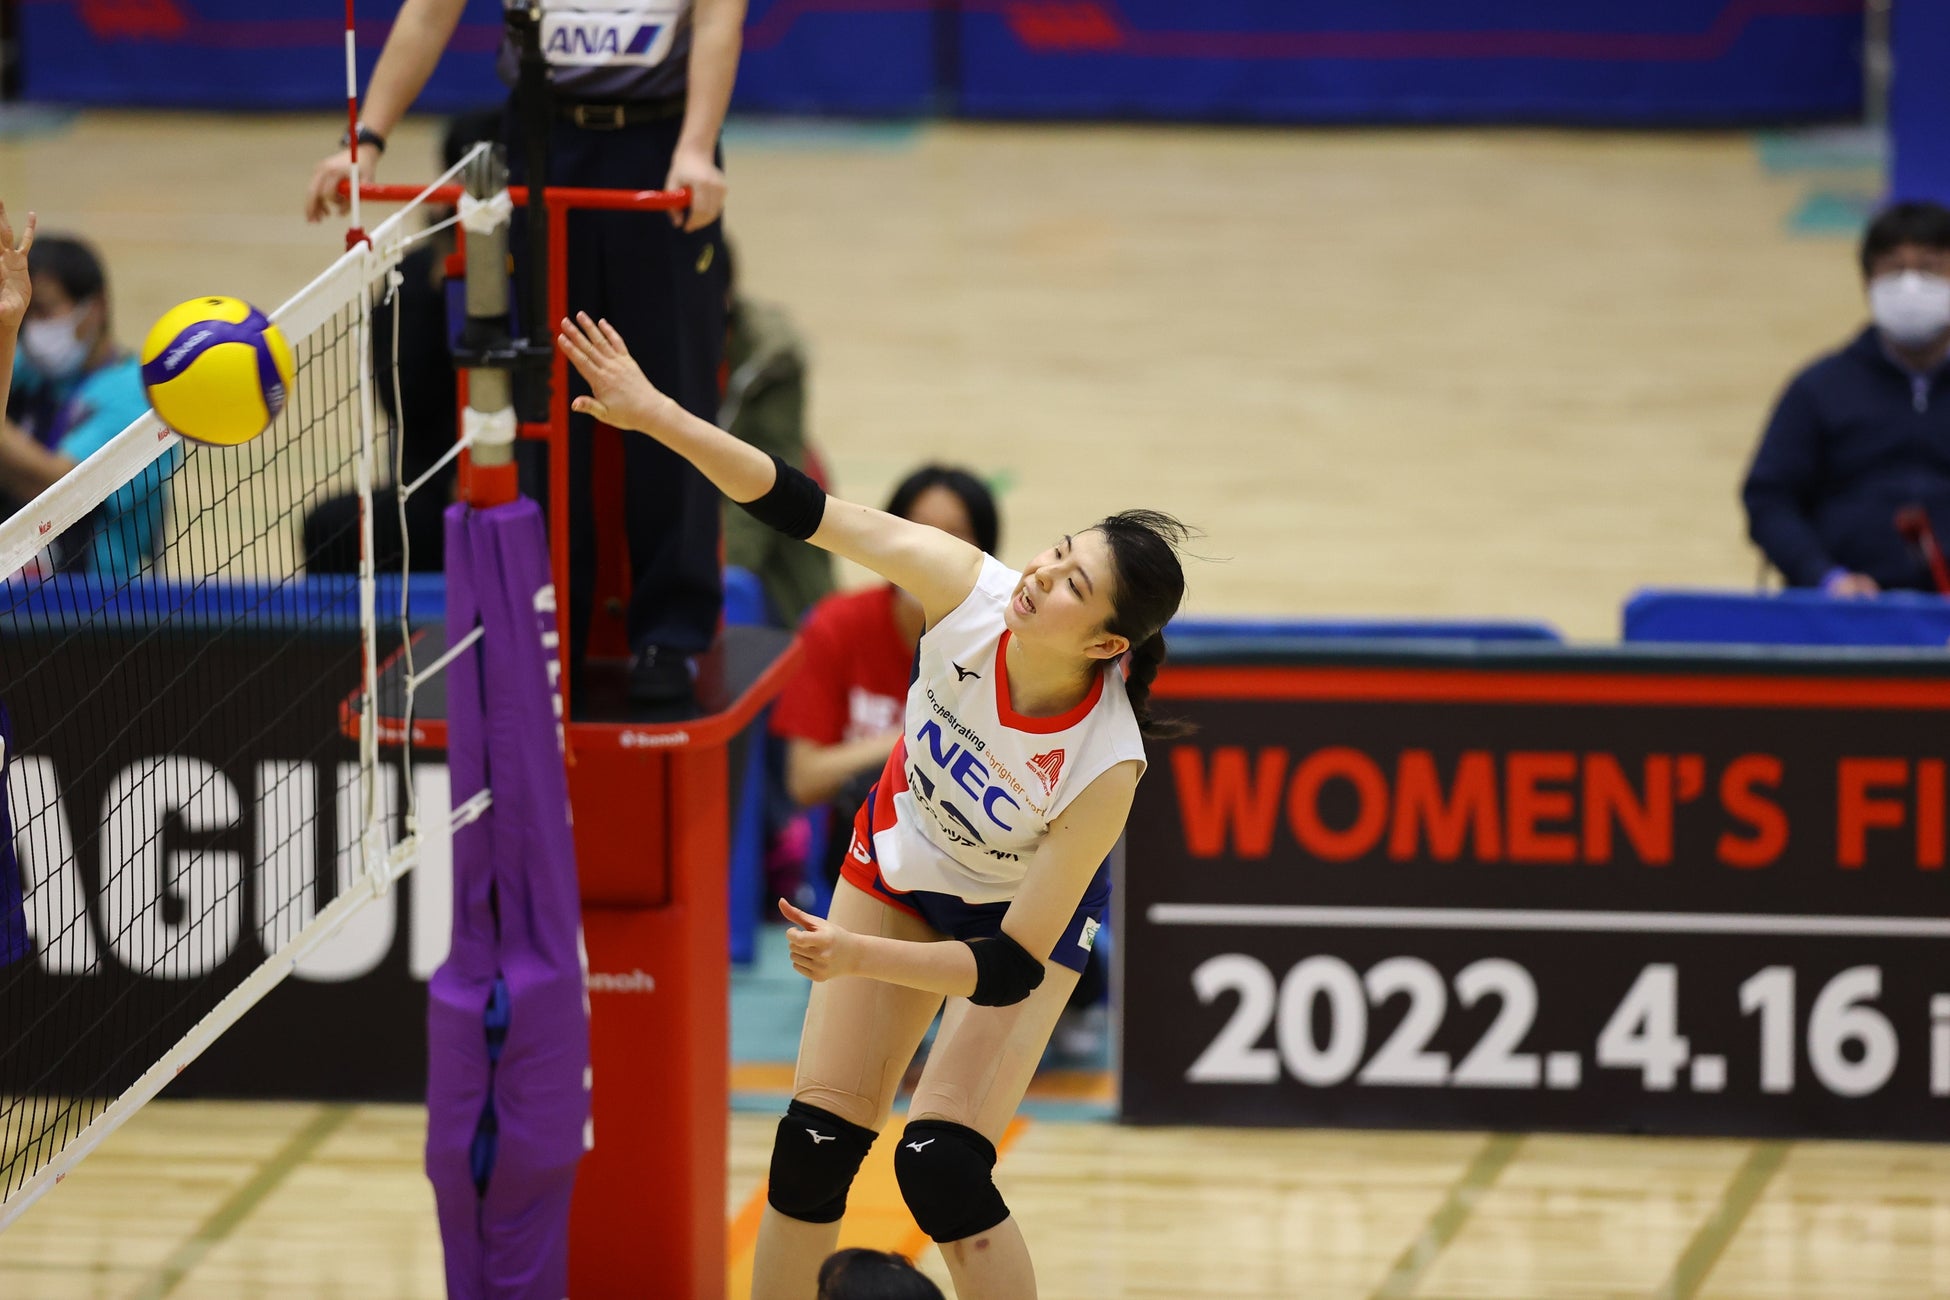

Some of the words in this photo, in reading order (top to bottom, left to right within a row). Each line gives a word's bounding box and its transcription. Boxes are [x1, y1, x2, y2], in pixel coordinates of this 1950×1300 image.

[548, 25, 620, 54] ANA
[917, 719, 1020, 832] NEC
[927, 689, 986, 751] Orchestrating
[989, 756, 1026, 795] brighter
[1171, 745, 1790, 868] WOMEN'S
[1836, 757, 1947, 871] FI
[1185, 953, 1900, 1098] 2022.4.16
